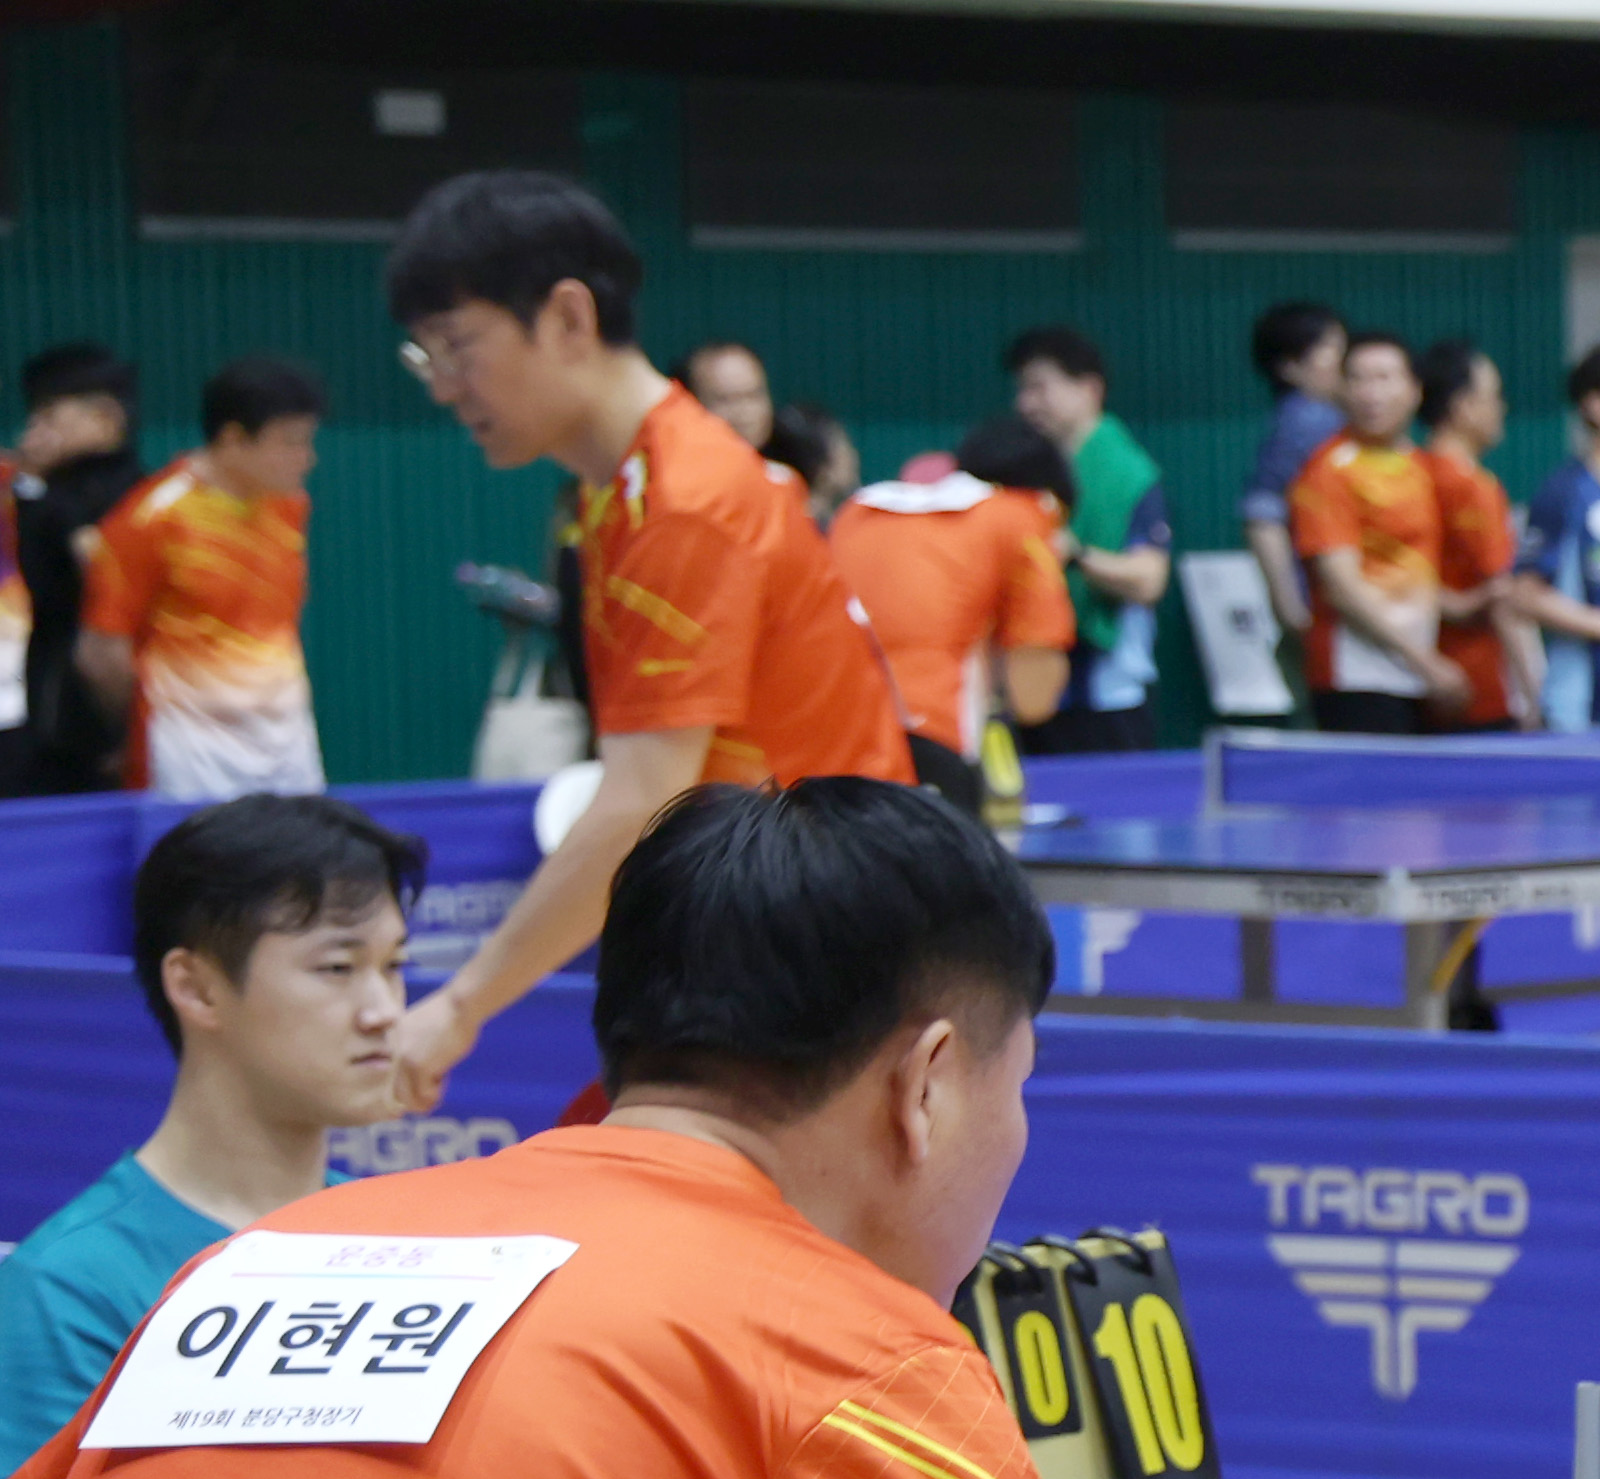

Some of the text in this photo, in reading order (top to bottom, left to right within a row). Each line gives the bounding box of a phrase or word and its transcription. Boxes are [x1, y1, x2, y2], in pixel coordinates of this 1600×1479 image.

[1252, 1164, 1529, 1236] TAGRO
[176, 1300, 476, 1378] 이현원
[168, 1404, 364, 1430] 제19회 분당구청장기
[1014, 1293, 1204, 1476] 0 10
